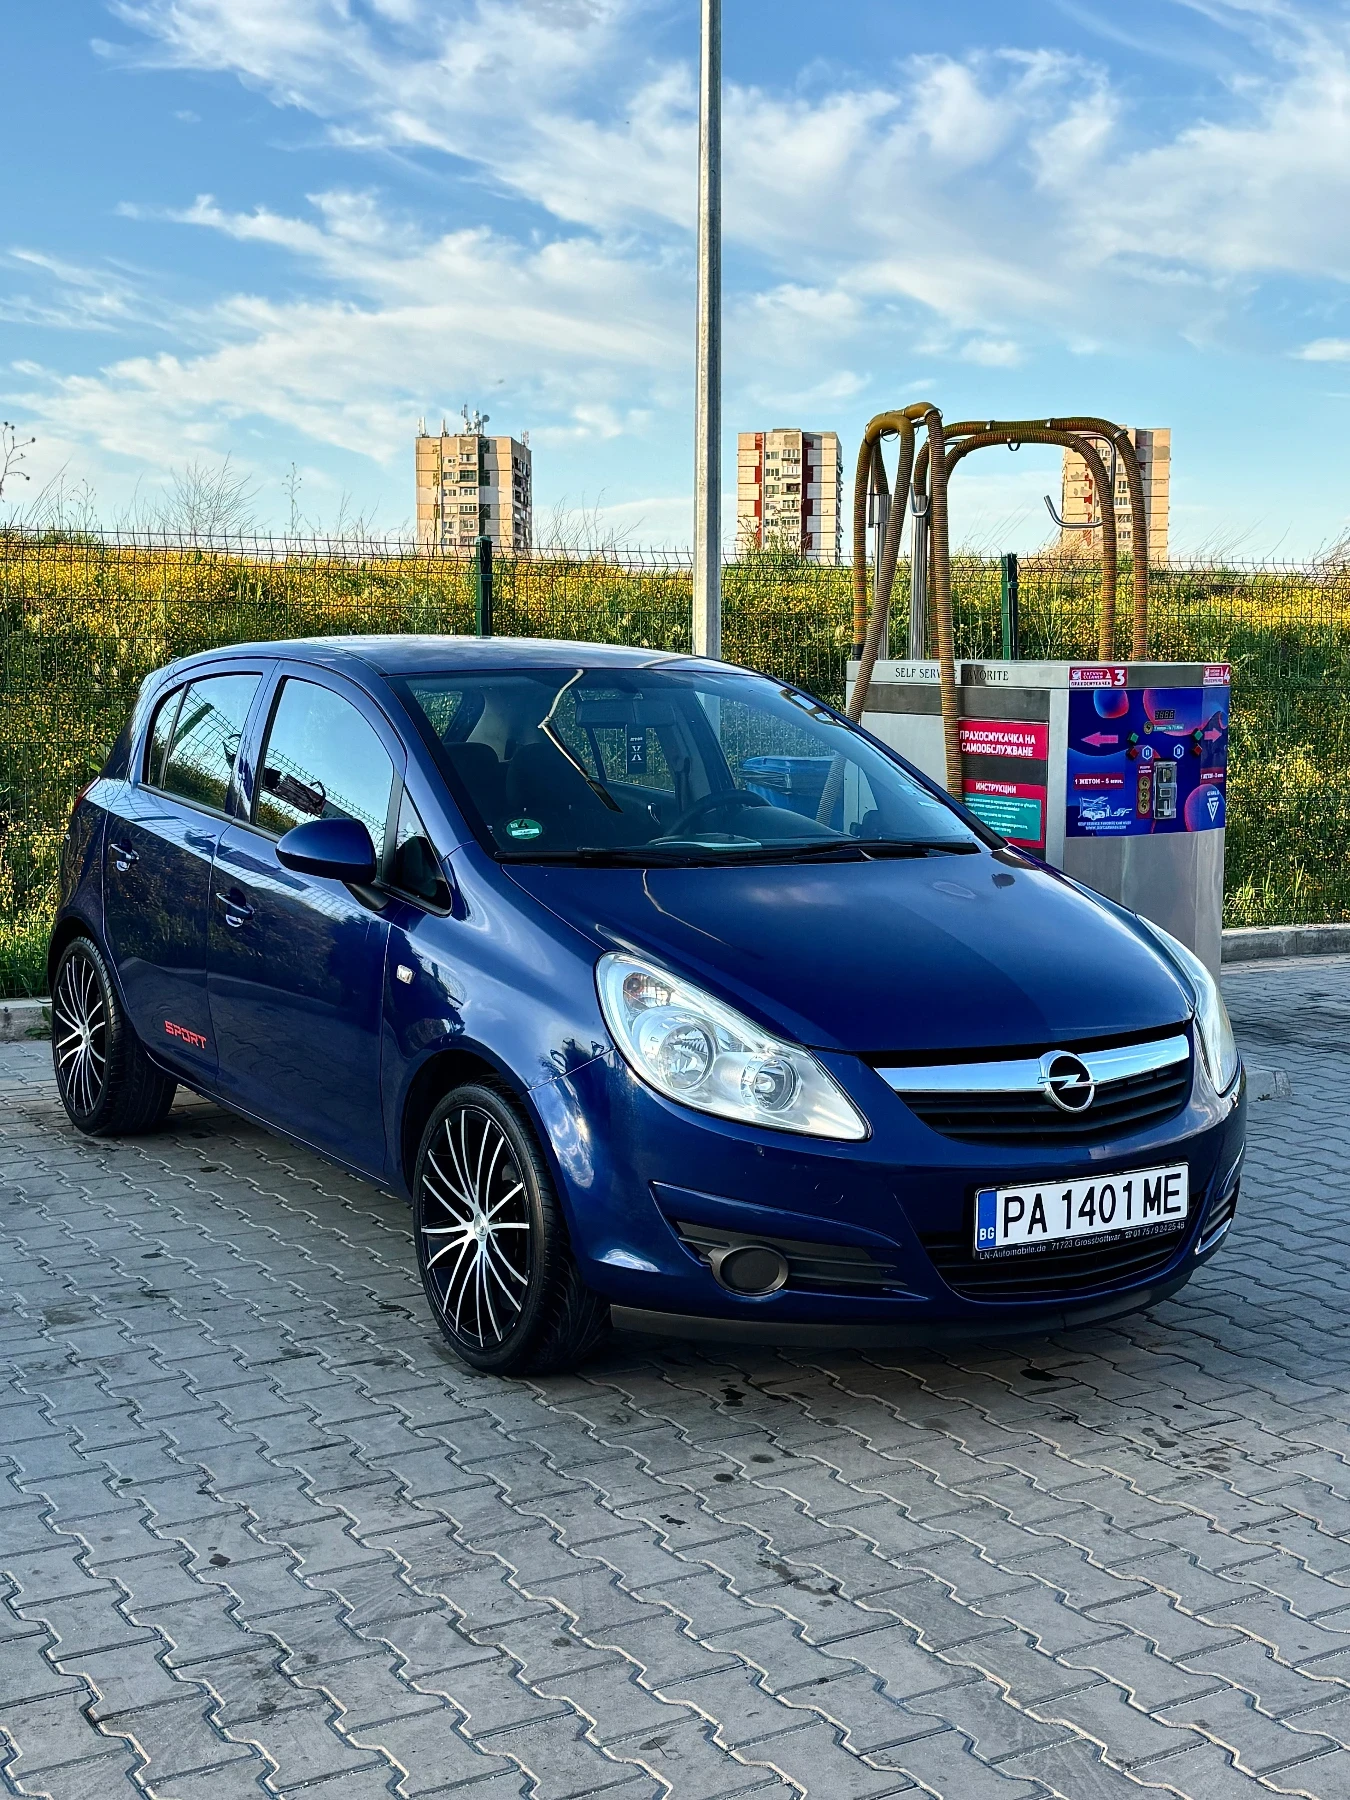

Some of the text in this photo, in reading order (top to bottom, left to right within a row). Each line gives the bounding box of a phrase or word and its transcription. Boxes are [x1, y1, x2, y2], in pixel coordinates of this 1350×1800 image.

[895, 667, 1009, 681] SELF SERVE FAVORITE
[1113, 669, 1125, 686] 3
[1223, 667, 1231, 683] 4
[960, 730, 1036, 744] ПРАХОСМУКАЧКА НА
[961, 742, 1034, 757] САМООБСЛУЖВАНЕ
[975, 782, 1017, 794] ИНСТРУКЦИИ
[164, 1020, 207, 1049] SPORT
[979, 1172, 1182, 1241] BG PA 1401 ME
